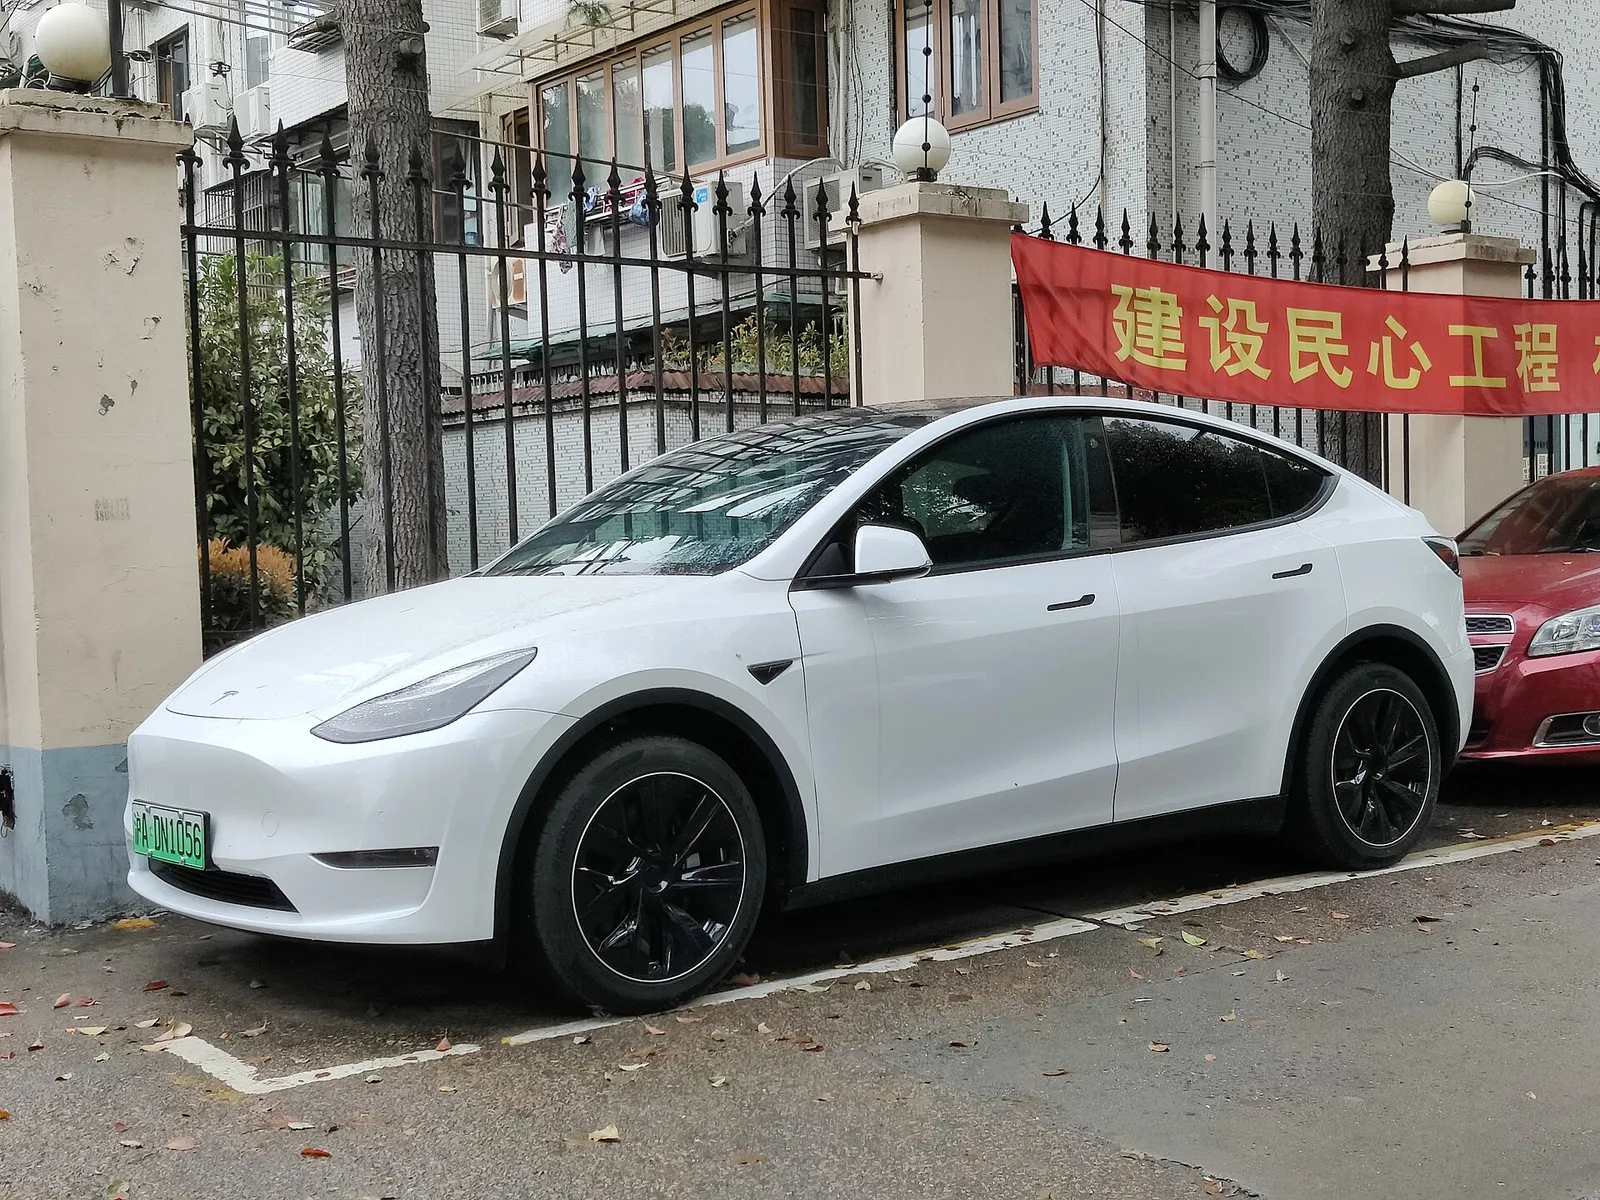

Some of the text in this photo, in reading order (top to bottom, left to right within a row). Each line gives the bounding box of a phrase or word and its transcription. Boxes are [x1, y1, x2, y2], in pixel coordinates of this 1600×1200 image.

[1110, 283, 1561, 394] 建设民心工程
[153, 814, 202, 860] DN1056
